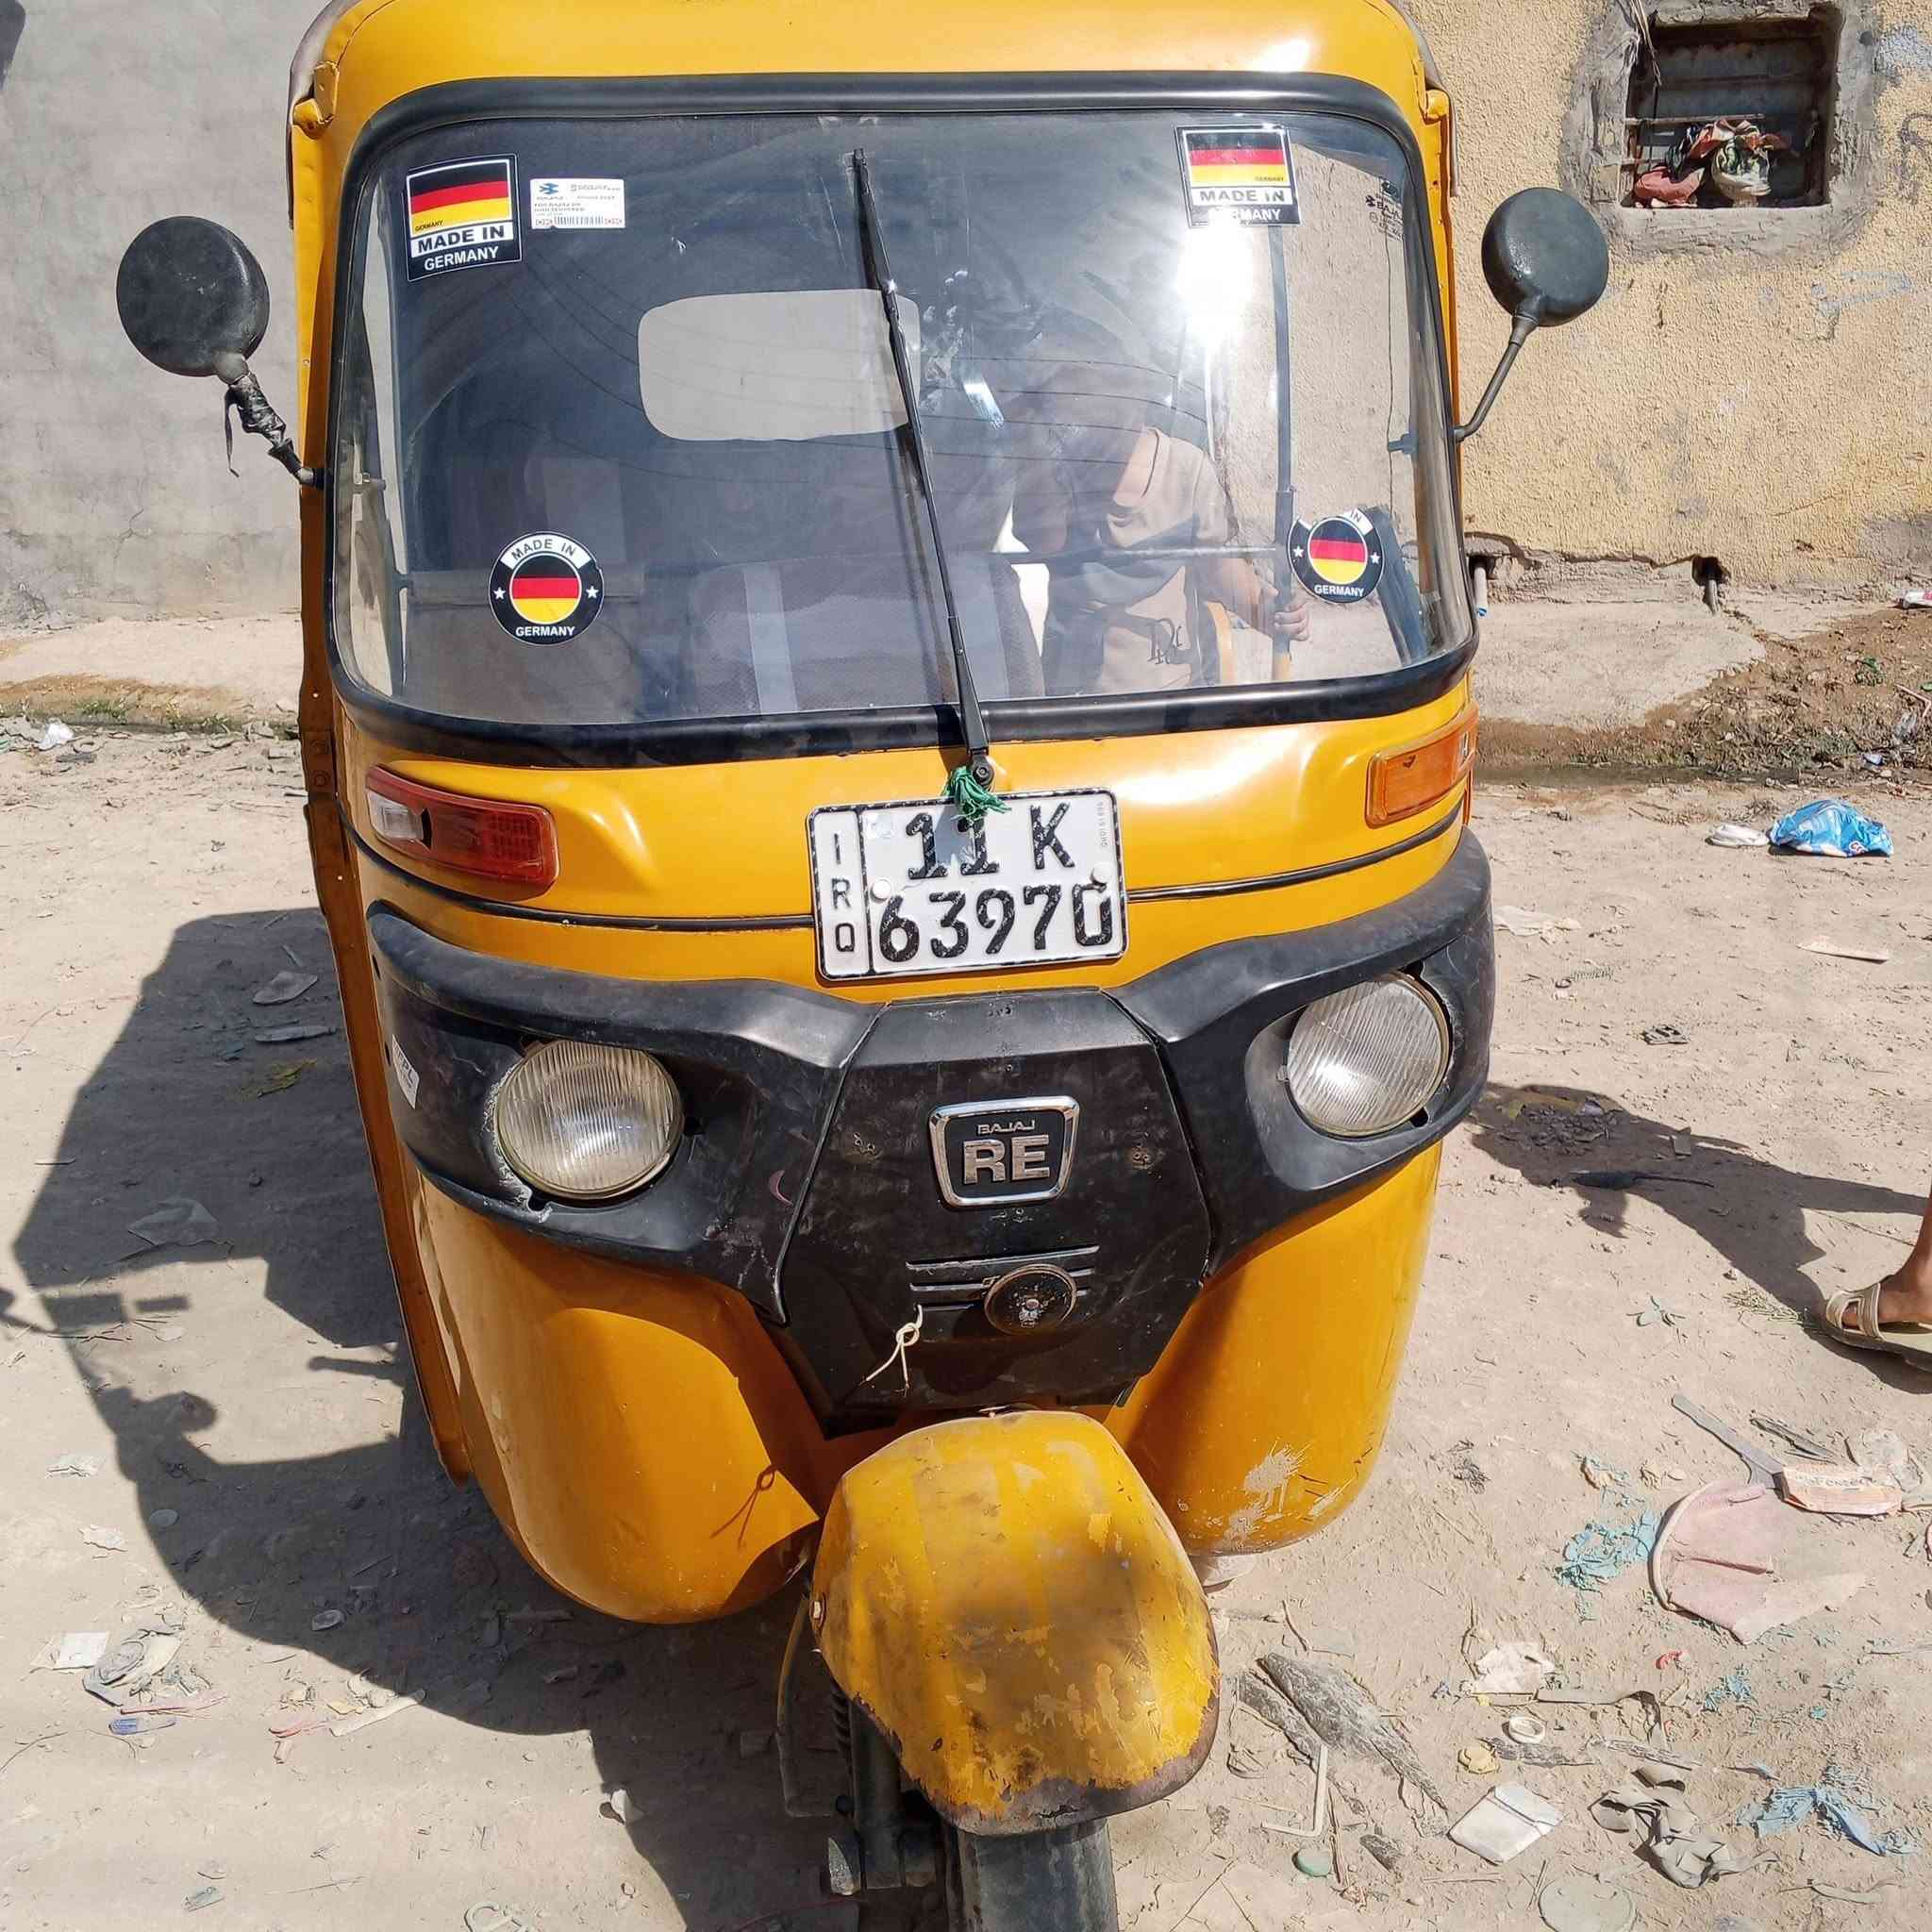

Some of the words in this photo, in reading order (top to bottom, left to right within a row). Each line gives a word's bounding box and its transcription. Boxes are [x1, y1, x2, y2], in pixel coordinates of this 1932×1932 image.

[1199, 190, 1258, 202] MADE
[1264, 190, 1286, 202] IN
[414, 220, 444, 232] GERMANY
[418, 229, 475, 255] MADE
[482, 225, 506, 240] IN
[424, 245, 500, 272] GERMANY
[510, 538, 554, 560] MADE
[560, 541, 577, 558] IN
[1313, 585, 1365, 597] GERMANY
[515, 625, 576, 638] GERMANY
[905, 810, 1001, 880] 11
[1029, 801, 1075, 870] K
[878, 882, 1113, 963] 63970
[976, 1119, 1036, 1136] BAJAJ
[962, 1133, 1051, 1185] RE
